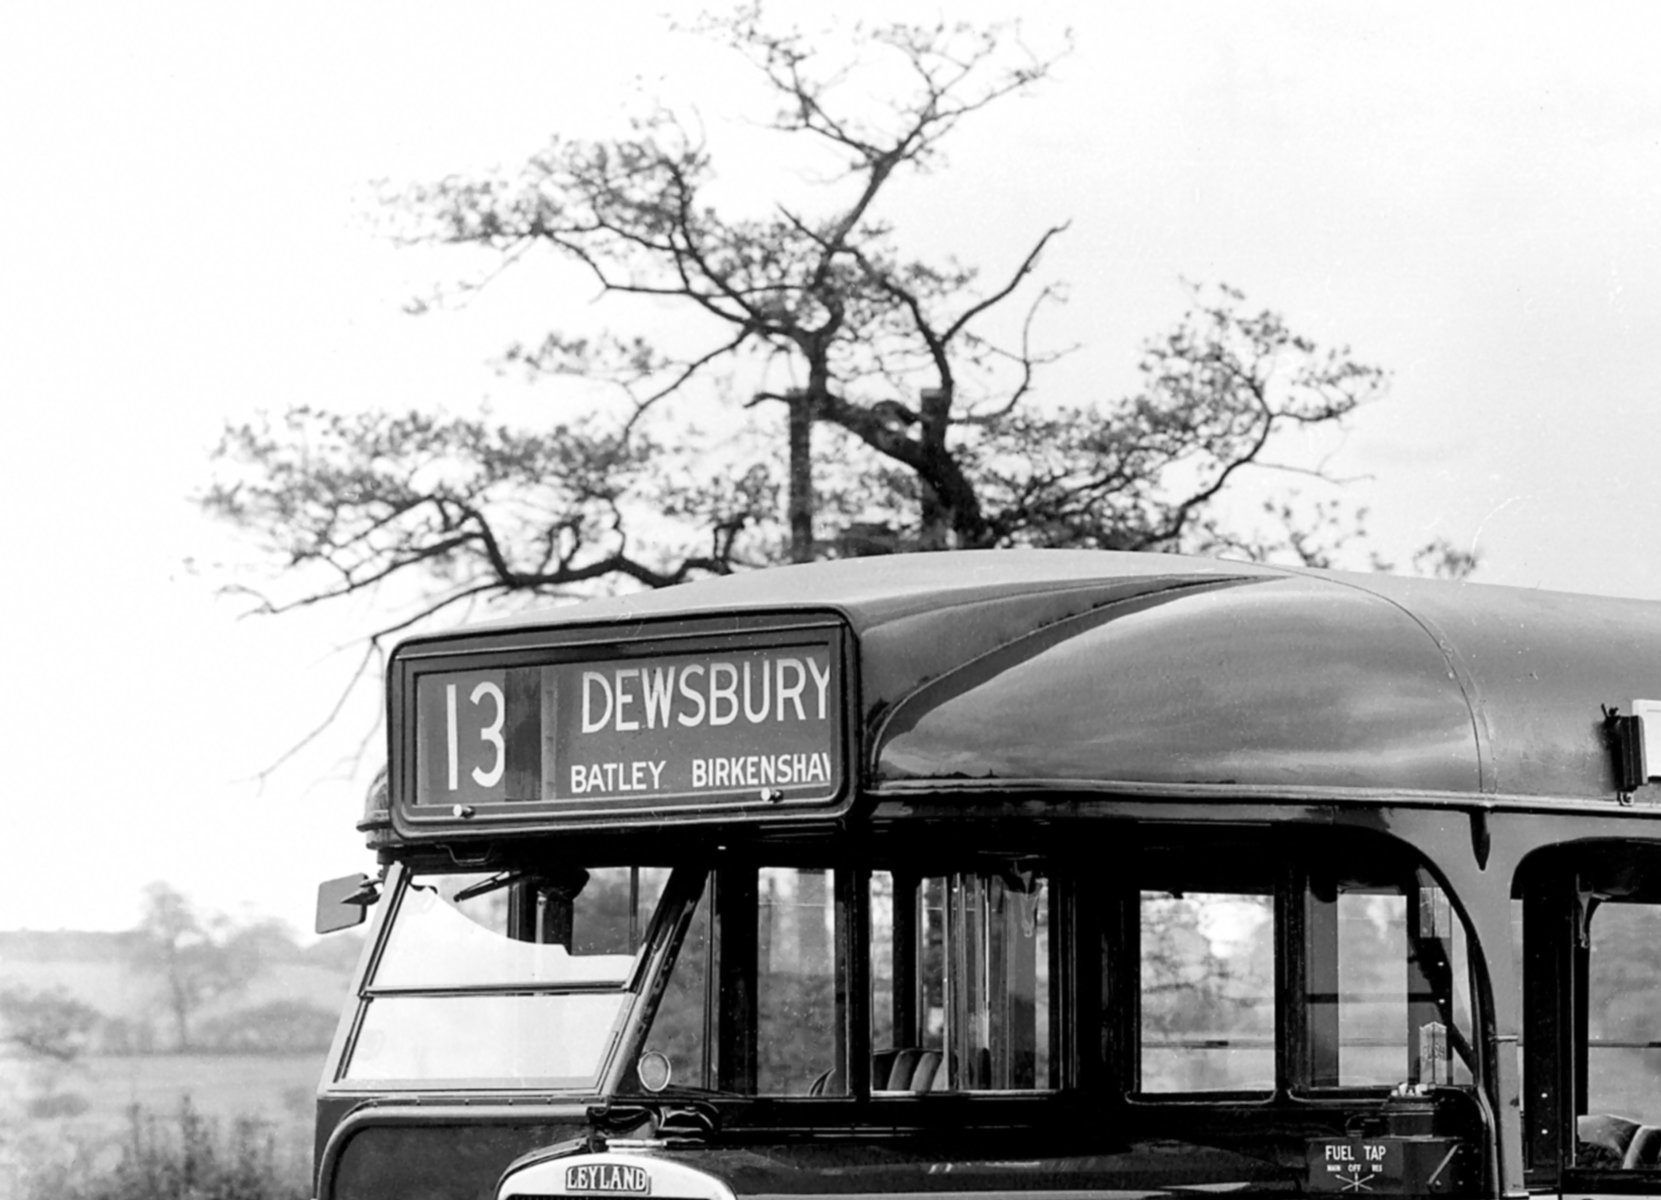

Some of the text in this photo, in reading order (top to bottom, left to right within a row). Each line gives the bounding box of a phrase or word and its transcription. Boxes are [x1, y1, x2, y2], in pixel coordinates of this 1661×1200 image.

[581, 656, 830, 734] DEWSBURY
[446, 681, 506, 790] 13
[570, 761, 667, 794] BATLEY
[1325, 1145, 1386, 1161] FUEL TAP
[566, 1165, 646, 1191] LEYLAND
